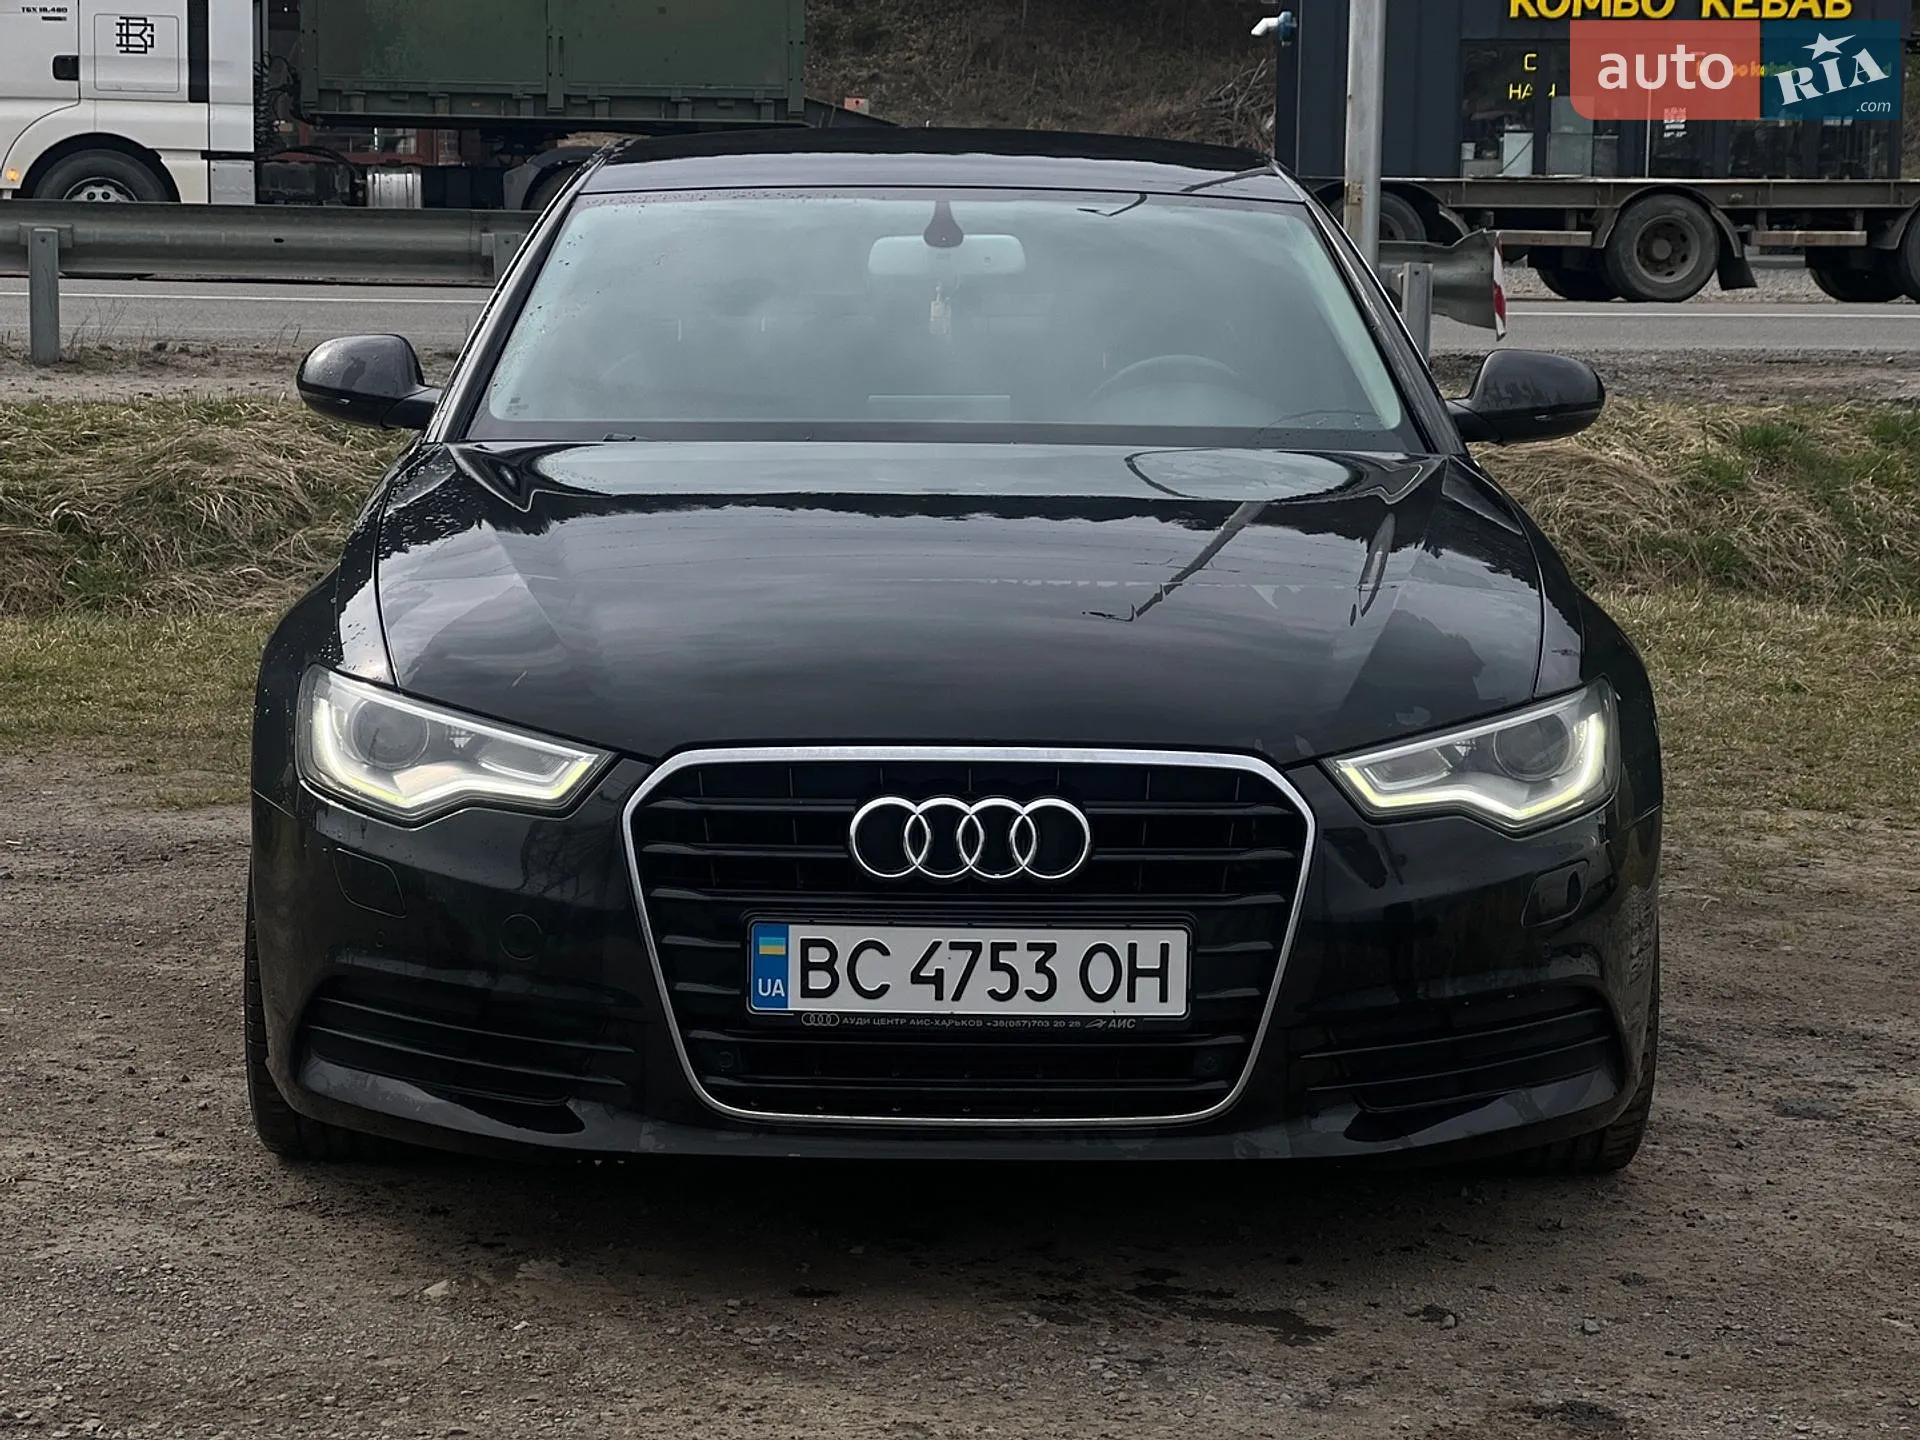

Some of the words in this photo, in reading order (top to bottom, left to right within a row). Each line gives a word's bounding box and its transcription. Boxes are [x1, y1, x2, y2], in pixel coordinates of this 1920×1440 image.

[1510, 0, 1676, 18] KOMBO
[1702, 0, 1852, 18] KEBAB
[800, 938, 891, 1000] BC
[911, 940, 1057, 1002] 4753
[1079, 942, 1170, 1003] OH
[758, 978, 786, 997] UA
[842, 1016, 871, 1026] АУДИ
[873, 1017, 907, 1026] ЦЕНТР
[1108, 1018, 1136, 1029] АИС
